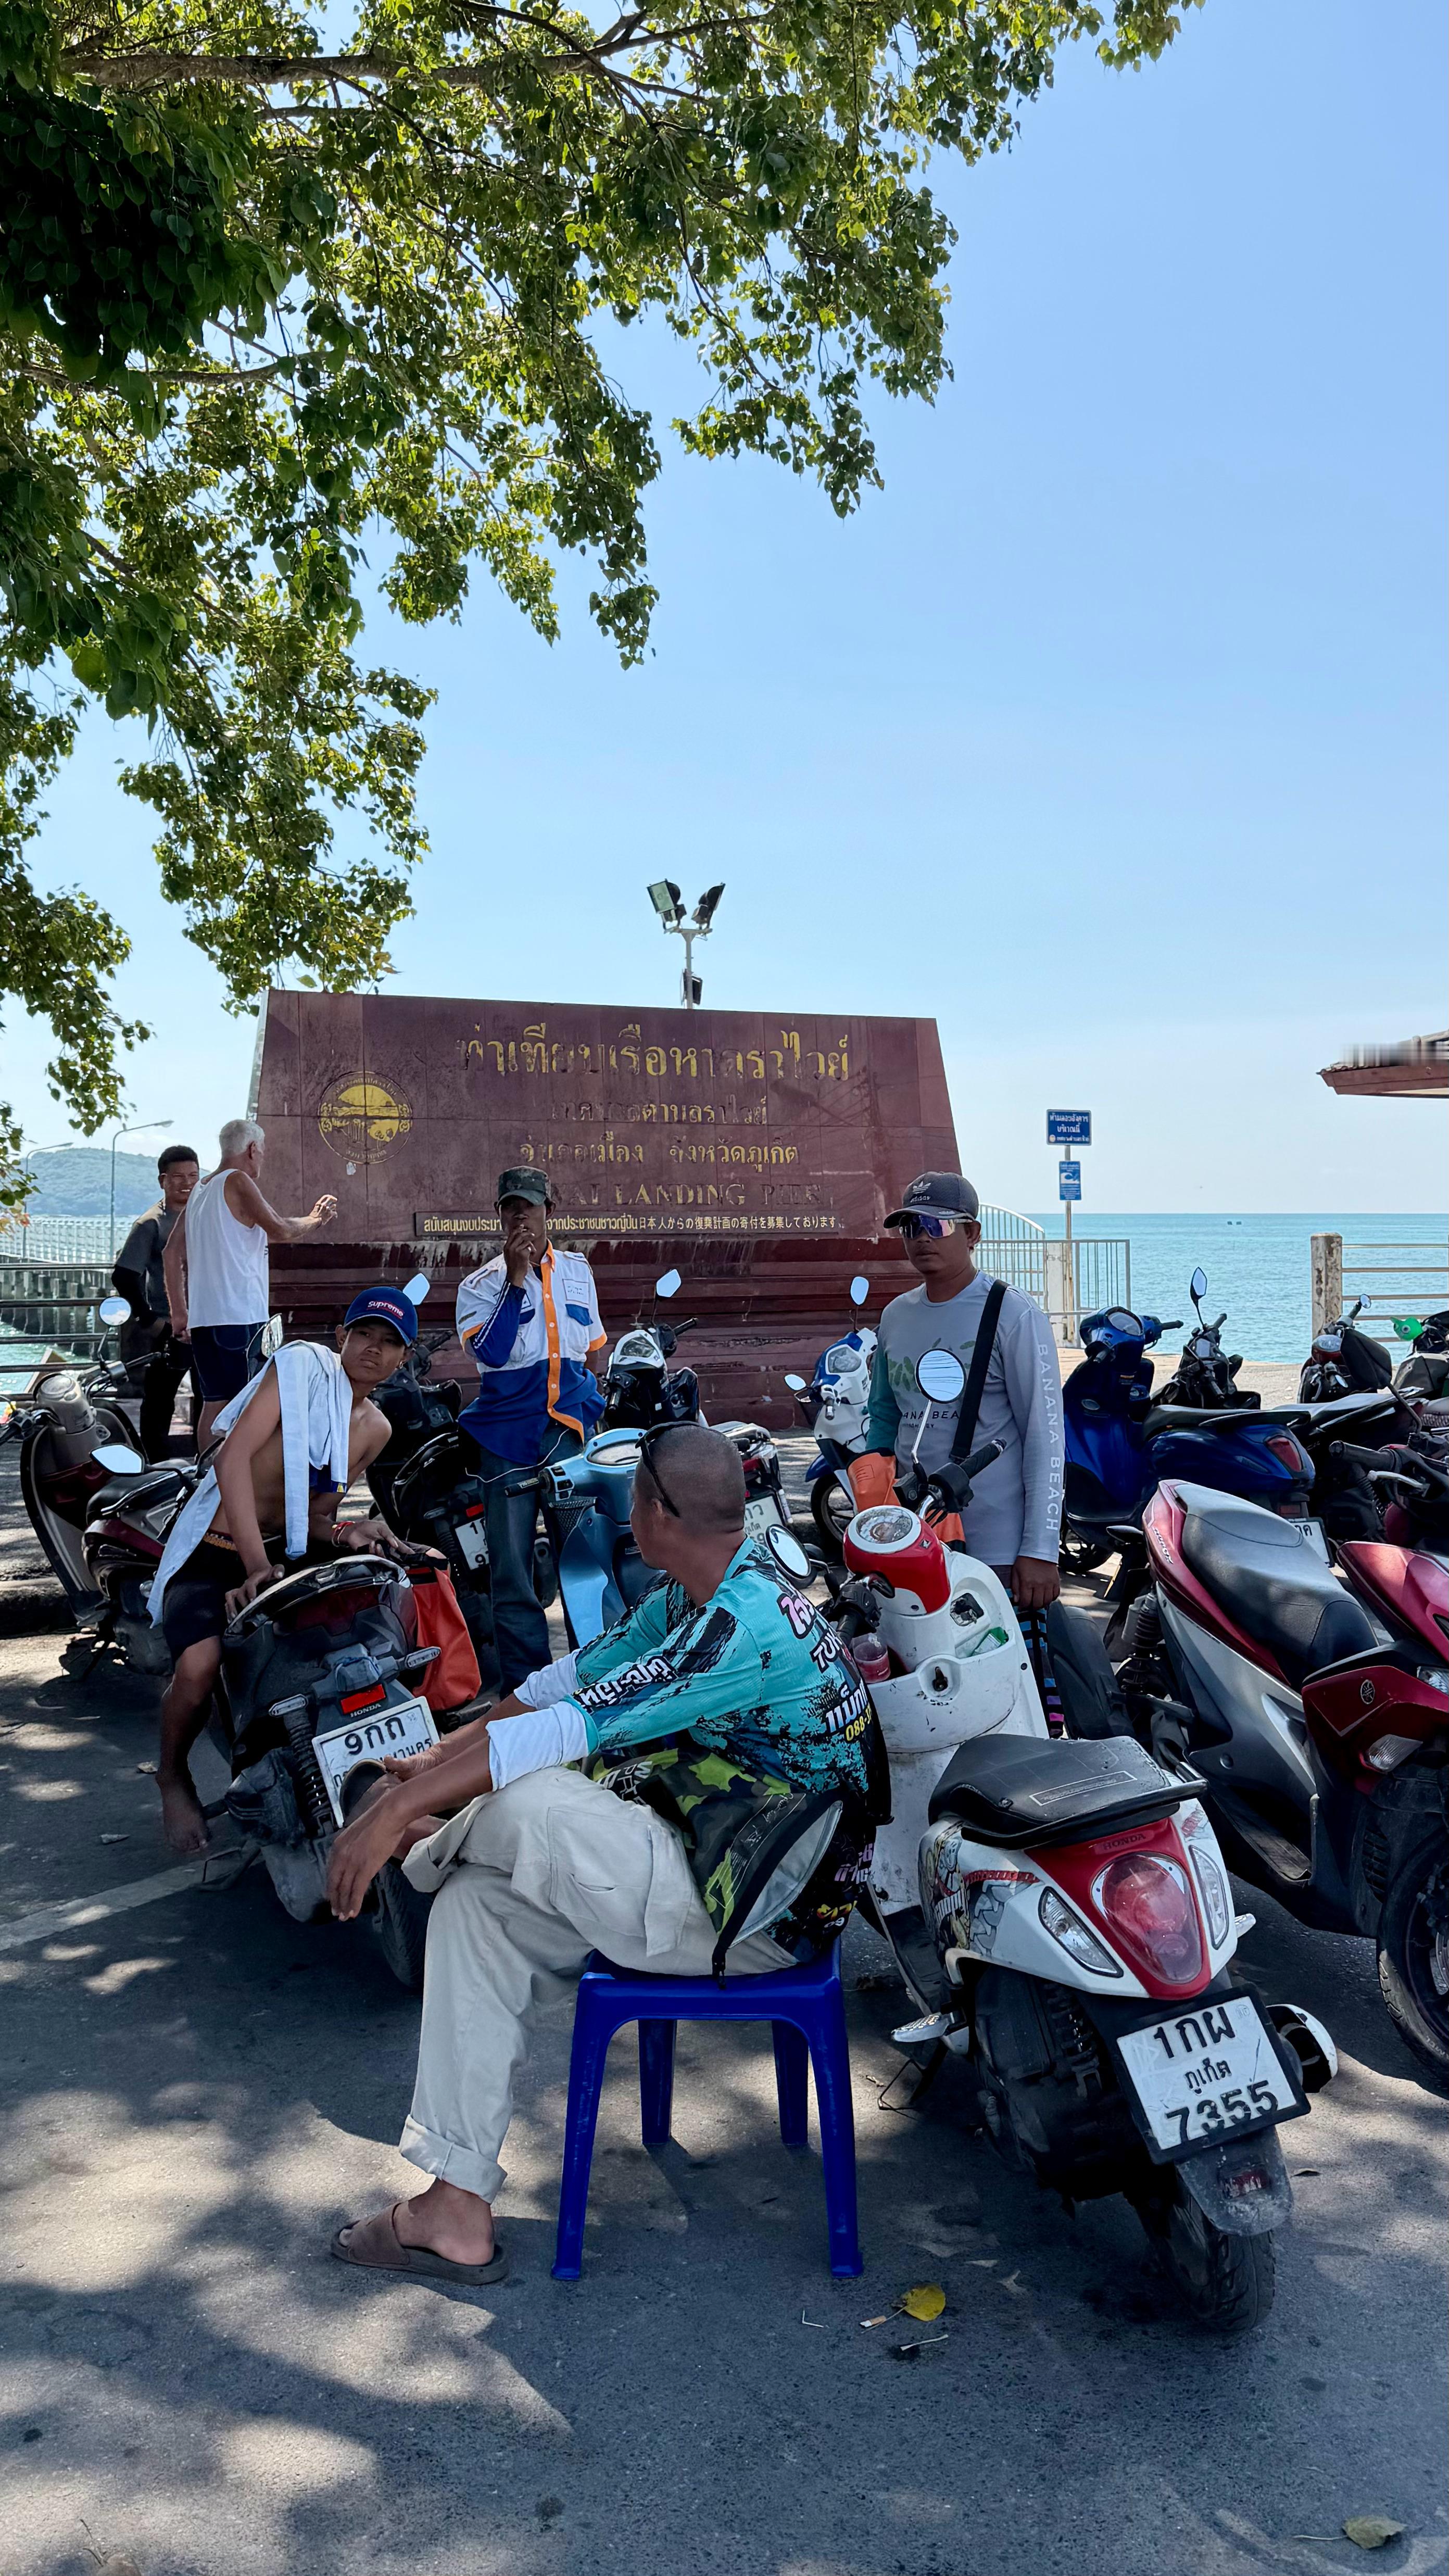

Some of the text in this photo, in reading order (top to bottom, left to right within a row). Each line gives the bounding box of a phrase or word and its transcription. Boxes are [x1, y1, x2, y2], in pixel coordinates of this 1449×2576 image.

[615, 1183, 746, 1206] LANDING
[424, 1216, 502, 1235] สนับสนุนงบประมา
[932, 1410, 959, 1419] BEA
[1038, 1343, 1061, 1531] BANANA BEACH
[350, 1703, 382, 1718] HONDA
[344, 1716, 406, 1756] 9กถ
[1103, 1833, 1147, 1850] HONDA
[1153, 2006, 1236, 2059] 1กผ
[1185, 2057, 1232, 2094] ภูเก็ต
[1165, 2079, 1279, 2143] 7355
